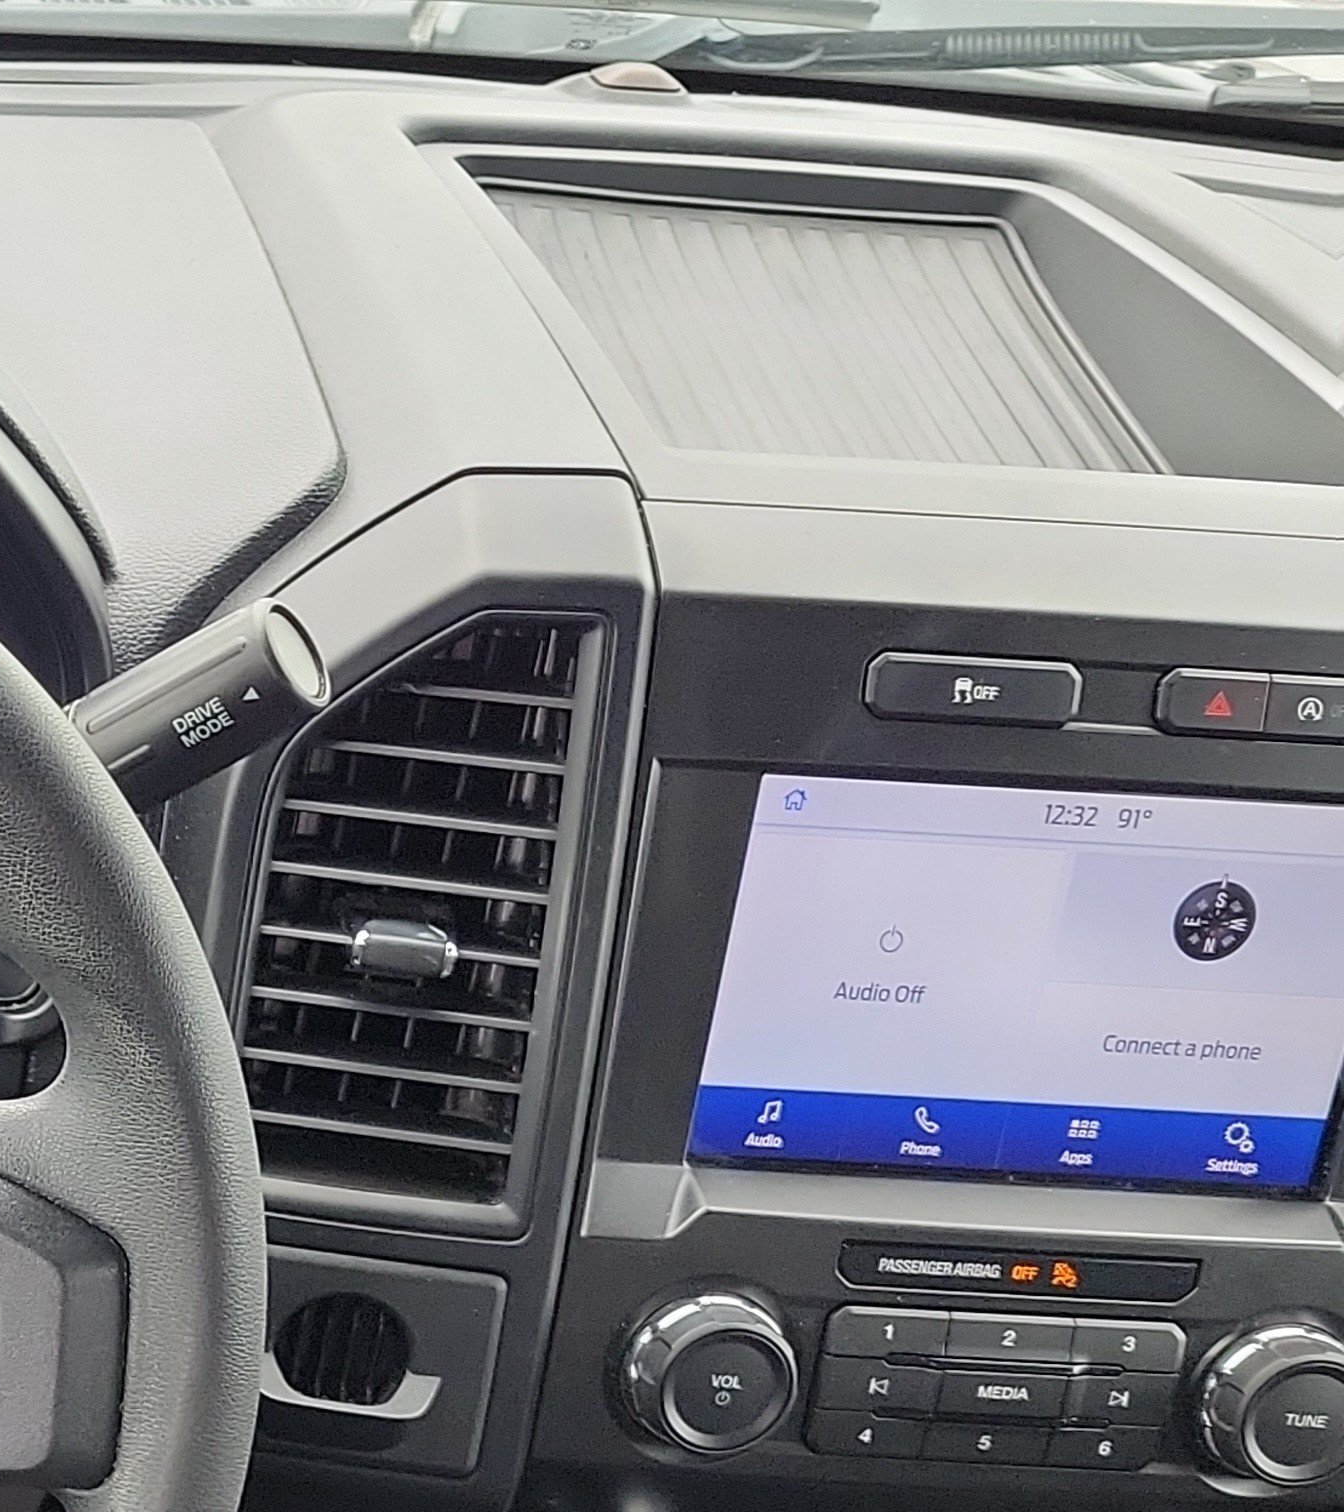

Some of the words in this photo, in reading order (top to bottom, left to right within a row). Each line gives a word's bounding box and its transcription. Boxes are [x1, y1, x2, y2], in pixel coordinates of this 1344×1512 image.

[973, 685, 1002, 701] OFF
[172, 696, 226, 734] DRIVE
[180, 711, 235, 748] MODE
[1043, 802, 1099, 828] 12:32
[1117, 806, 1153, 830] 91°
[1215, 891, 1229, 909] S
[832, 981, 889, 1003] Audio
[895, 983, 927, 1005] Off
[1103, 1034, 1182, 1059] Connect
[1184, 1042, 1197, 1058] a
[1199, 1038, 1263, 1063] phone
[744, 1132, 783, 1149] Audio
[899, 1140, 941, 1157] Phone
[1059, 1150, 1094, 1168] Apps
[1206, 1158, 1258, 1176] Settings
[877, 1257, 952, 1277] PASSENGER
[952, 1261, 1002, 1279] AIRBAG
[1012, 1265, 1040, 1281] OFF
[883, 1324, 895, 1340] 1
[1002, 1330, 1016, 1347] 2
[1123, 1336, 1136, 1352] 3
[711, 1374, 742, 1391] VOL
[976, 1385, 1030, 1402] MEDIA
[1284, 1413, 1328, 1430] TUNE
[858, 1428, 873, 1444] 4
[977, 1435, 992, 1451] 5
[1098, 1441, 1112, 1457] 6
